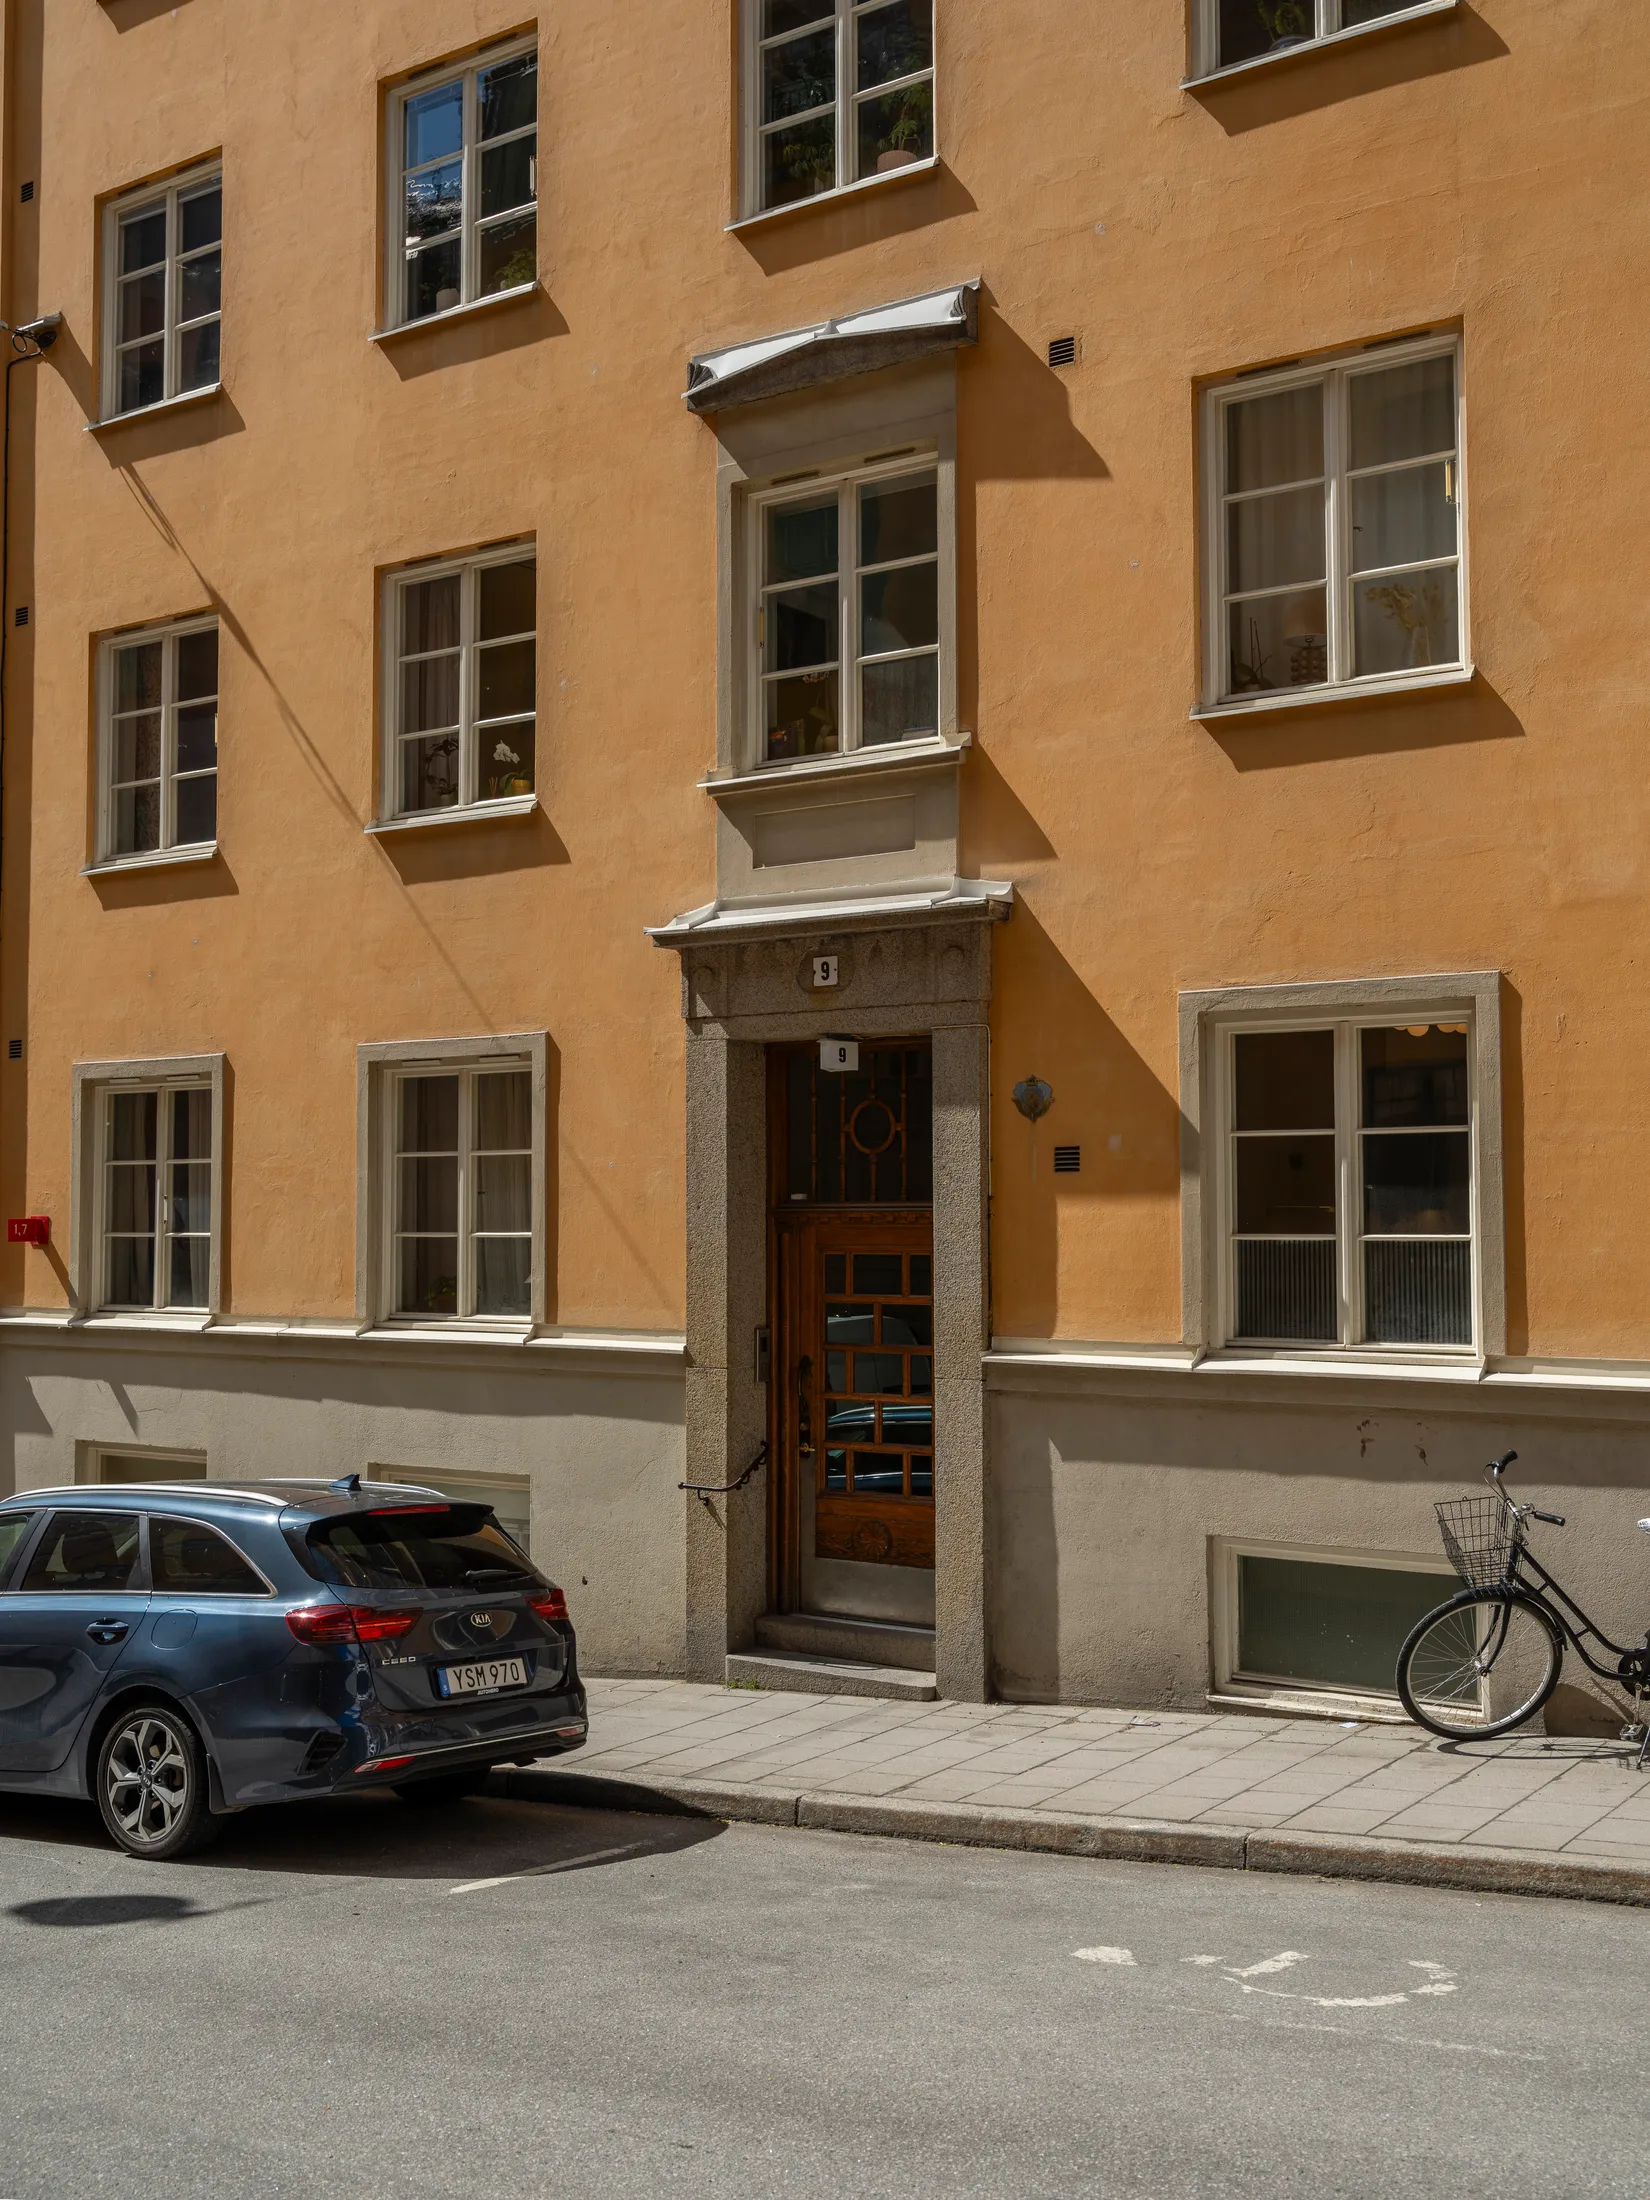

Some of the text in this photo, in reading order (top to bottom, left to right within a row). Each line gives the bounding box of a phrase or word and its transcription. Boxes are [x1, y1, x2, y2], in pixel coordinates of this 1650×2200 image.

[820, 961, 830, 981] 9
[838, 1047, 846, 1063] 9
[14, 1223, 28, 1236] 1,7
[475, 1614, 490, 1624] KIA
[453, 1662, 520, 1689] YSM 970
